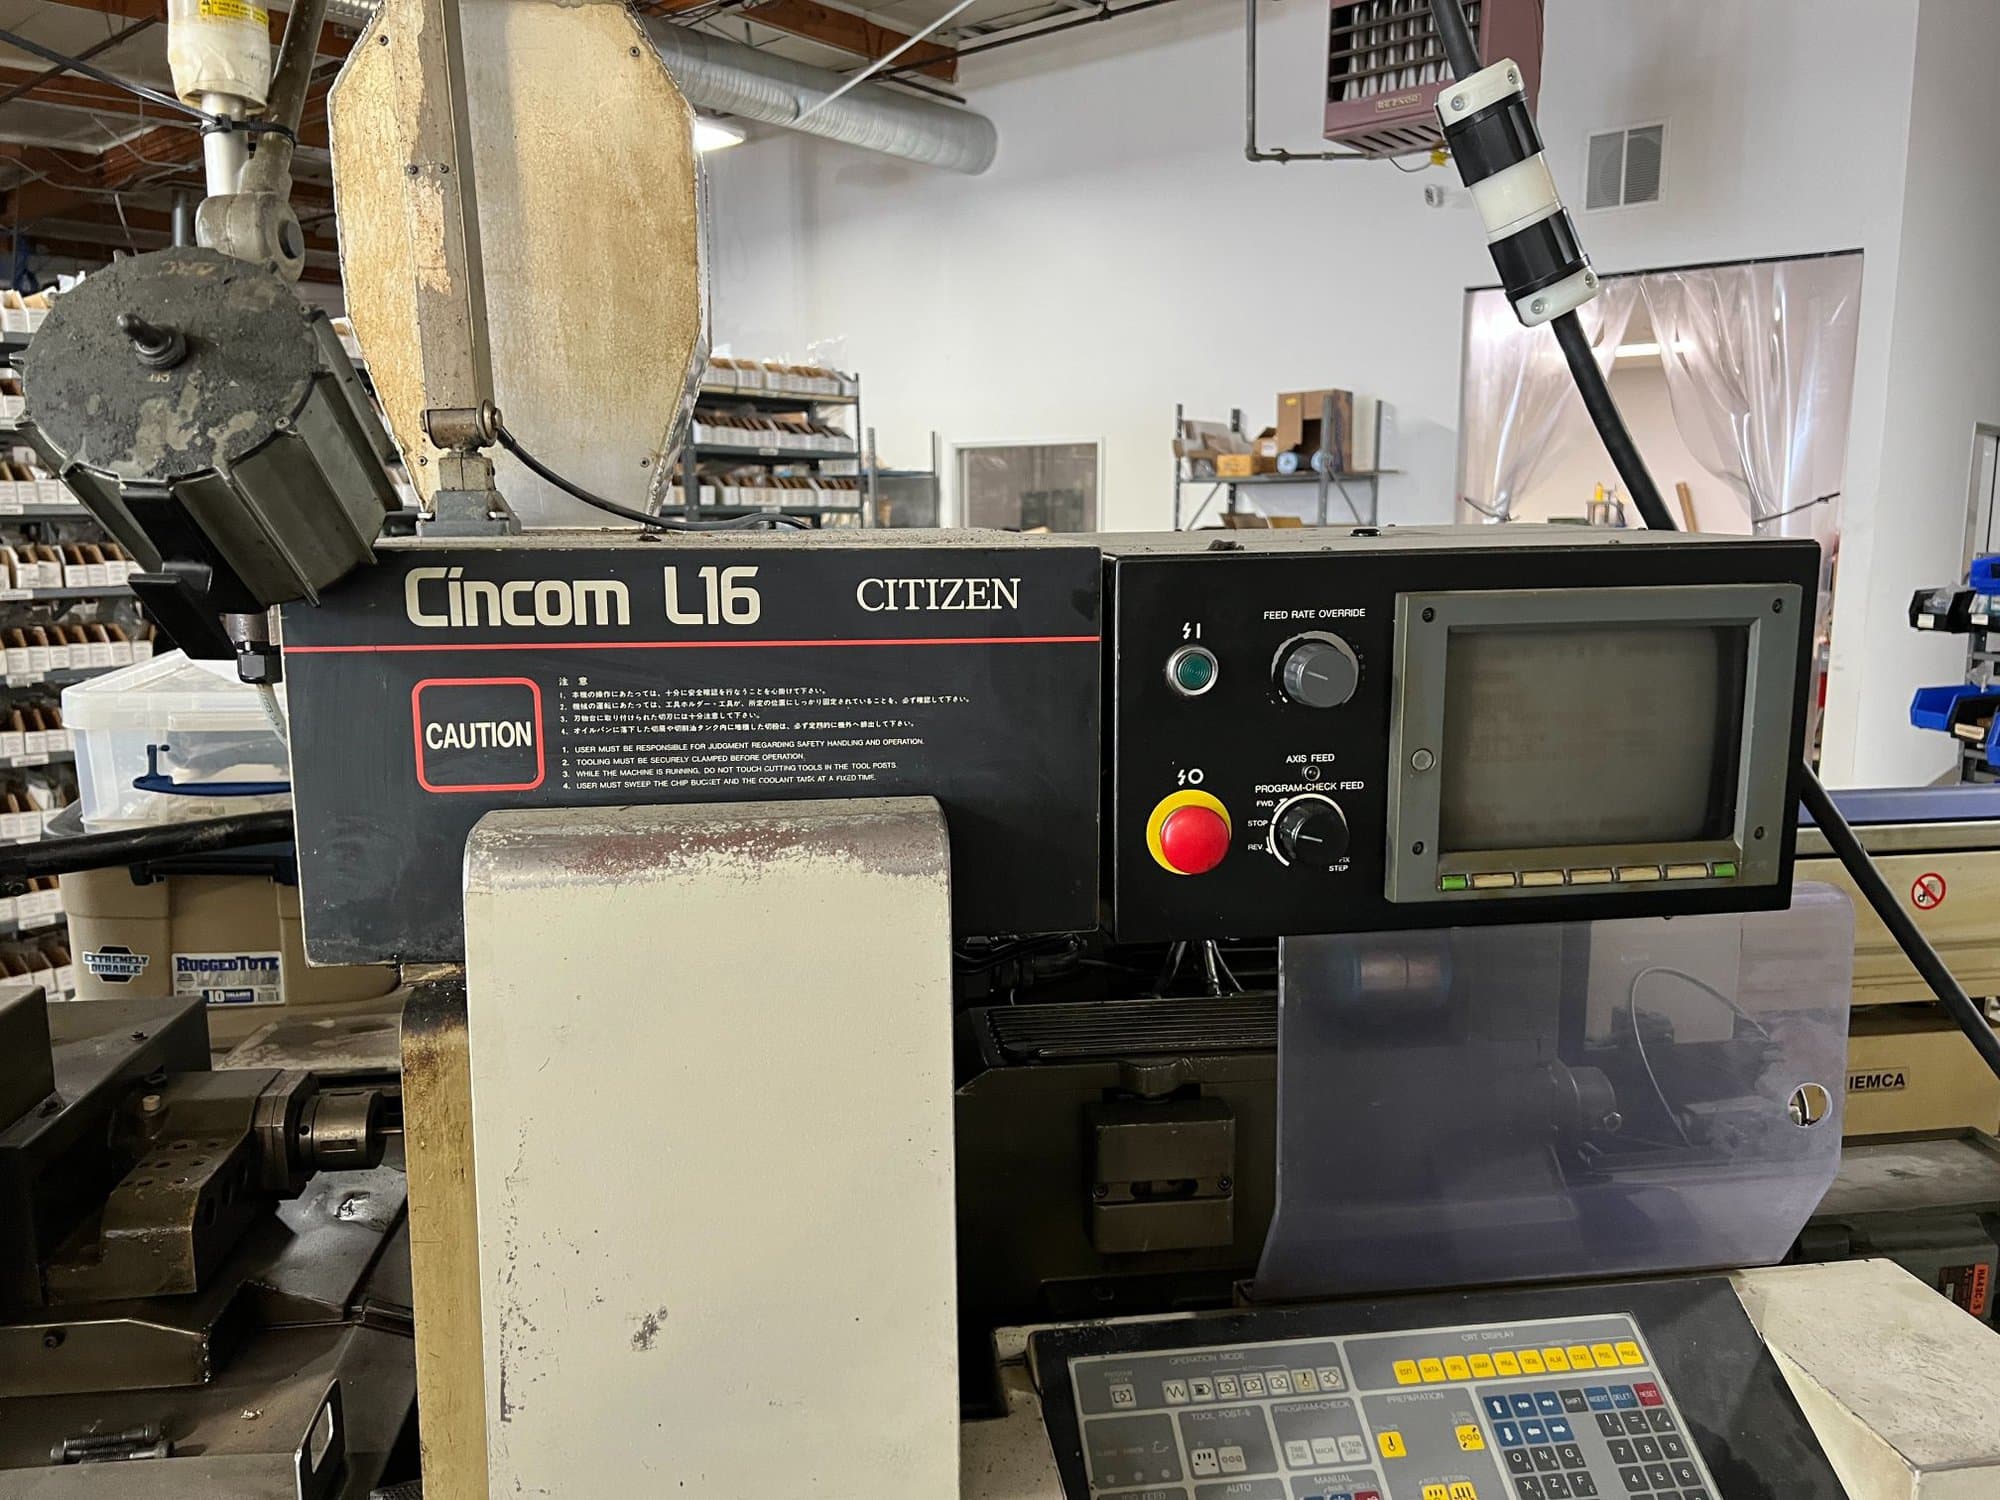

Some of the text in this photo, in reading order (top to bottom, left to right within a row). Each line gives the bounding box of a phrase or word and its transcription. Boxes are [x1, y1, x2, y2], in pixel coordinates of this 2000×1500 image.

[405, 566, 761, 627] Cincom L16
[856, 578, 1021, 611] CITIZEN
[1263, 608, 1366, 620] FEED RATE OVERRIDE
[426, 721, 532, 750] CAUTION
[562, 746, 569, 754] 1.
[575, 745, 596, 753] USER
[636, 743, 688, 751] RESPONSIBLE
[708, 742, 749, 750] JUDGMENT
[751, 741, 795, 749] REGARDING
[797, 740, 825, 748] SAFETY
[827, 739, 864, 747] HANDLING
[692, 755, 728, 763] CLAMPED
[730, 754, 760, 762] BEFORE
[1286, 753, 1335, 763] AXIS FEED
[619, 768, 654, 776] MACHINE
[656, 768, 664, 776] IS
[735, 765, 762, 773] TOUCH
[1255, 781, 1364, 793] PROGRAM-CHECK FEED
[1247, 819, 1269, 828] STOP
[84, 953, 149, 966] EXTREMELY
[90, 964, 142, 974] DURABLE
[208, 989, 225, 1003] 10
[1849, 1073, 1905, 1089] IEMCA
[1618, 1447, 1624, 1456] 7
[1643, 1444, 1652, 1454] 8
[1669, 1442, 1677, 1451] 9
[1538, 1450, 1548, 1460] N
[1564, 1448, 1574, 1458] G
[1631, 1474, 1639, 1483] 4
[1656, 1472, 1664, 1481] 5
[1681, 1469, 1690, 1479] 6
[1523, 1480, 1533, 1490] X
[1550, 1478, 1559, 1488] Z
[1576, 1475, 1584, 1485] F
